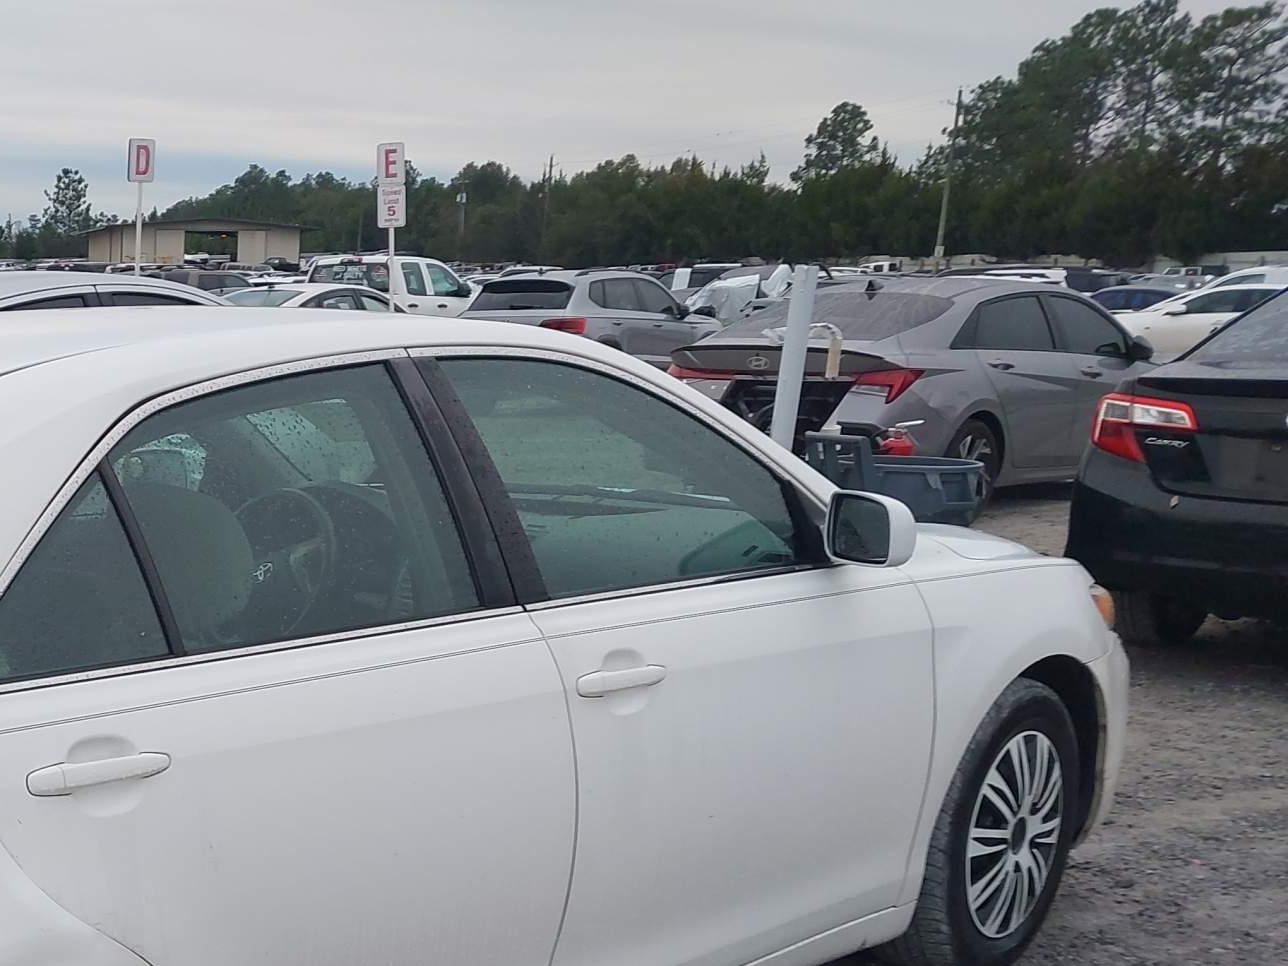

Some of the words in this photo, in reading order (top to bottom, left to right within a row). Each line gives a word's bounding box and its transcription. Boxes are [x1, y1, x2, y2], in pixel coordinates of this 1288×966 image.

[136, 145, 150, 175] D
[384, 149, 397, 178] E
[387, 205, 396, 216] 5
